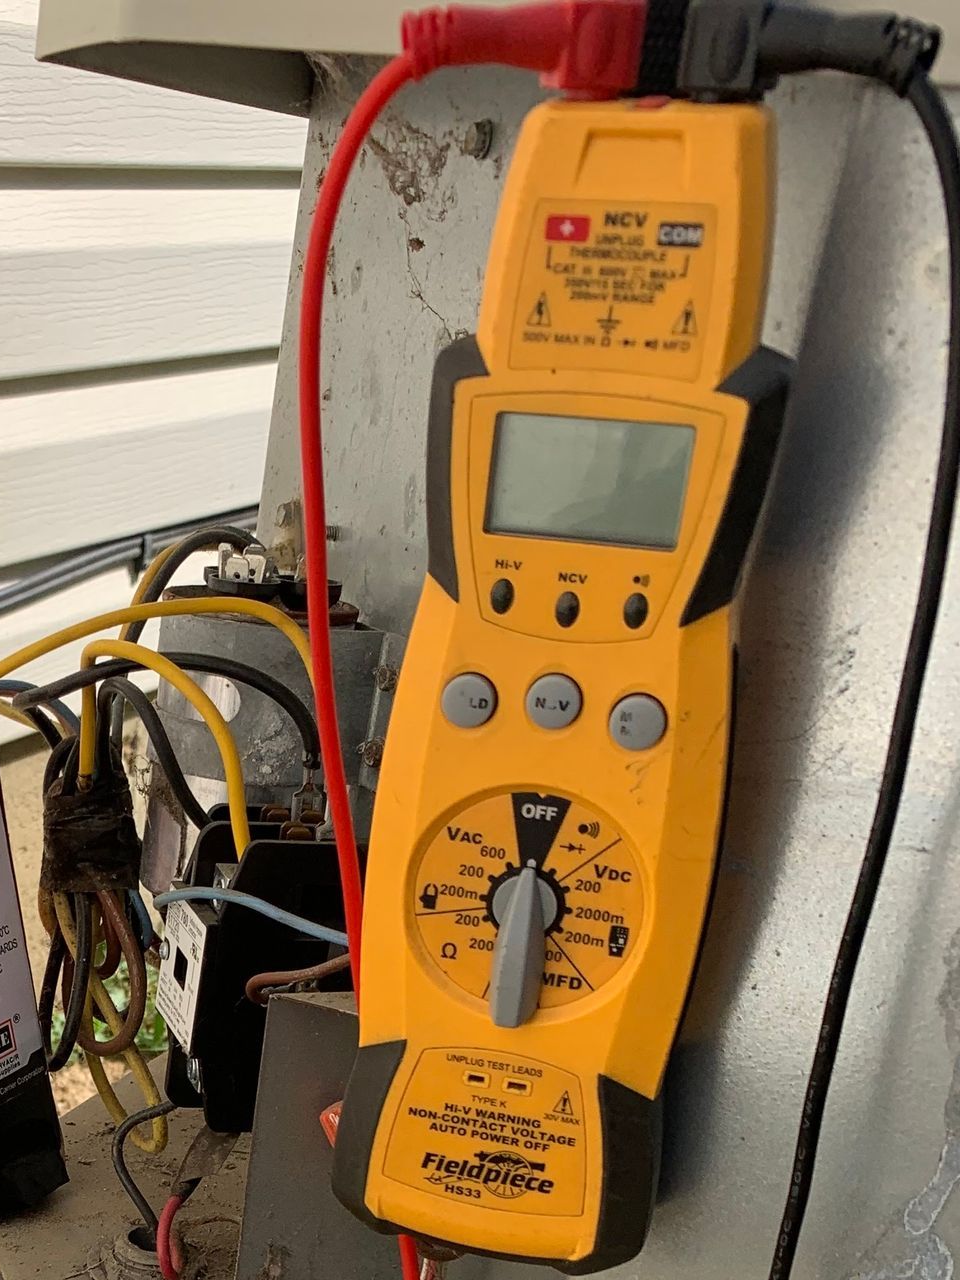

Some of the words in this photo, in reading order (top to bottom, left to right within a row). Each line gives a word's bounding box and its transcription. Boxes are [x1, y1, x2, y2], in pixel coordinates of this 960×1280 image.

[604, 211, 648, 227] NCV
[595, 233, 644, 246] UNPLUG
[657, 223, 704, 245] COM
[570, 246, 667, 262] THERMOCOUPLE
[495, 559, 523, 571] Hi-V
[558, 572, 588, 585] NCV
[535, 697, 570, 712] NV
[521, 803, 558, 822] OFF
[446, 826, 483, 845] VAC
[480, 846, 506, 860] 600
[459, 864, 485, 878] 200
[593, 864, 633, 883] VDC
[440, 884, 479, 900] 200m
[574, 879, 602, 894] 200
[454, 913, 480, 928] 200
[574, 907, 624, 925] 2000m
[564, 931, 605, 947] 200m
[545, 950, 563, 963] 00
[446, 1053, 485, 1067] UNPLUG
[487, 1060, 511, 1072] TEST
[512, 1065, 544, 1078] LEADS
[0, 1080, 17, 1096] Carrier
[471, 1095, 497, 1107] TYPE
[499, 1100, 507, 1108] K
[444, 1103, 472, 1115] Hi-V
[475, 1108, 541, 1129] WARNING
[543, 1112, 561, 1122] 30V
[561, 1115, 581, 1126] MAX
[408, 1107, 506, 1133] NON-CONTACT
[511, 1126, 577, 1147] VOLTAGE
[429, 1122, 467, 1136] AUTO
[471, 1131, 520, 1147] POWER
[524, 1140, 551, 1152] OFF
[421, 1152, 555, 1195] Fieldpiece
[444, 1183, 482, 1199] HS33
